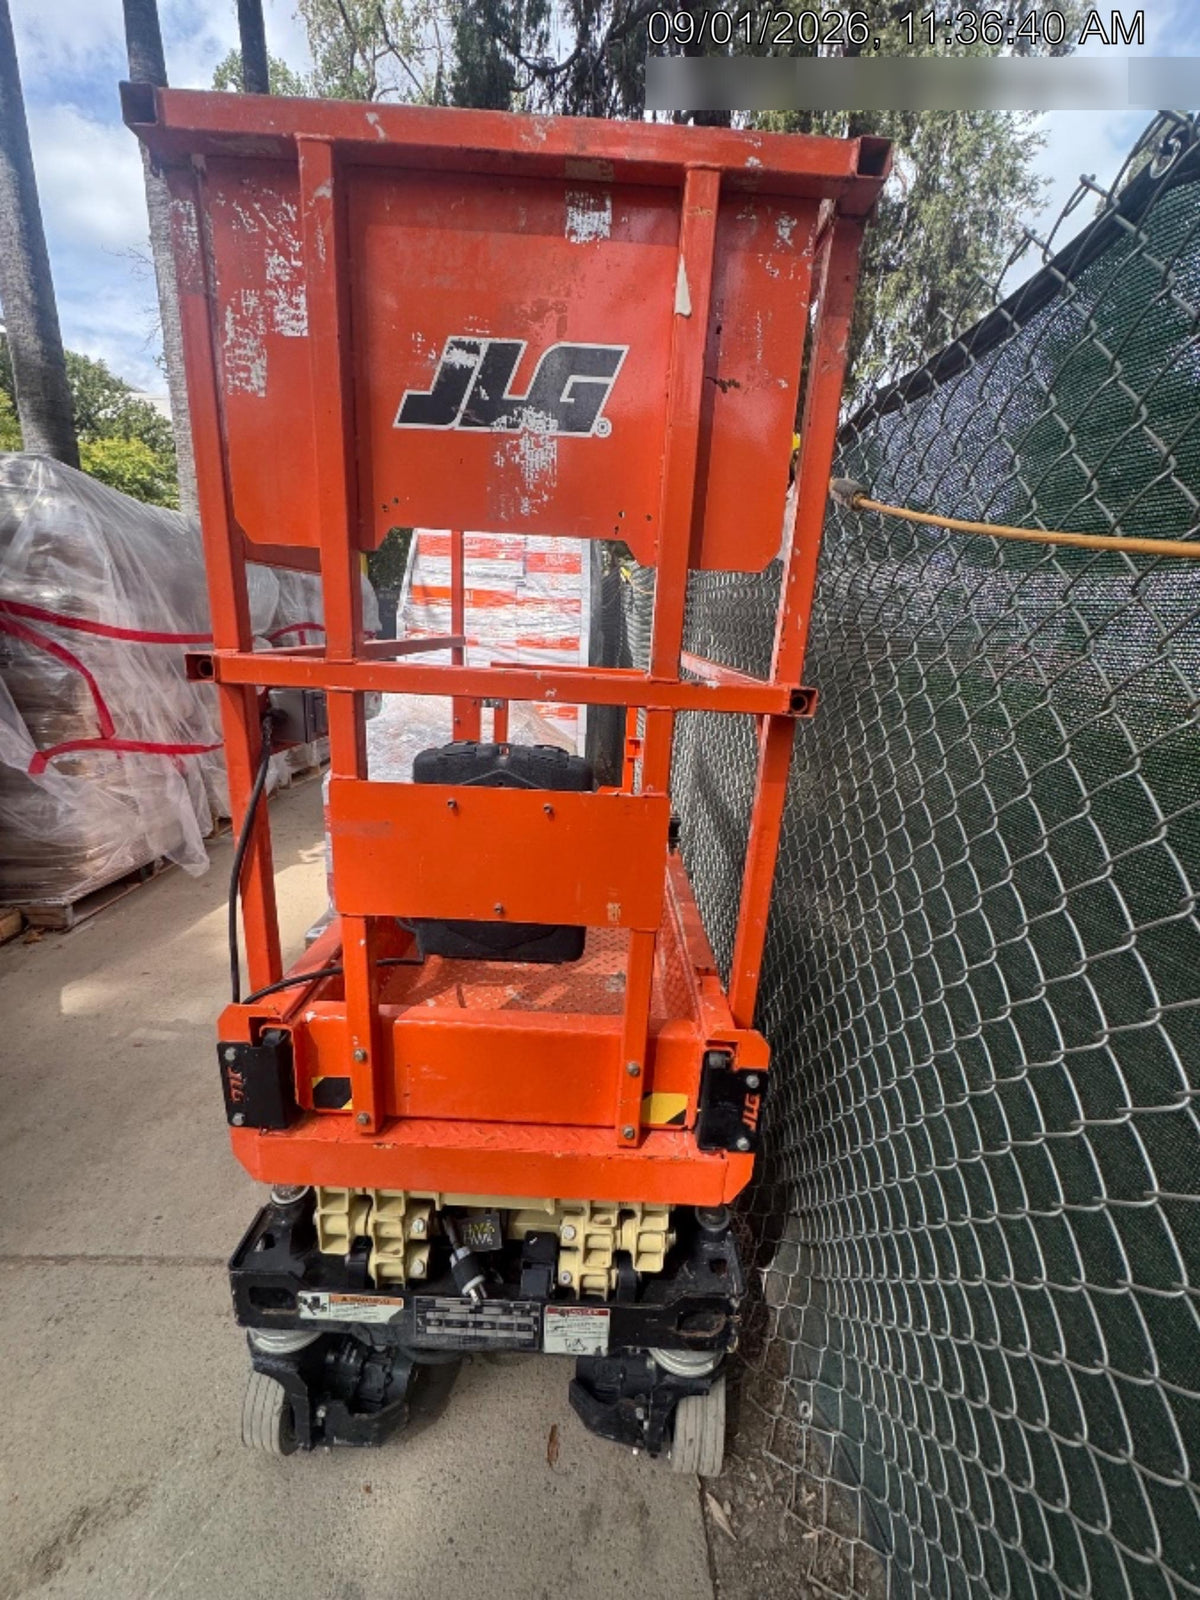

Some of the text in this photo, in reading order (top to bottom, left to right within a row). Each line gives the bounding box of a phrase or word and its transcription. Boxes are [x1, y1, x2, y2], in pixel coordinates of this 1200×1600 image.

[393, 335, 630, 438] JLG
[227, 1066, 244, 1102] JLG
[742, 1093, 761, 1132] JLG
